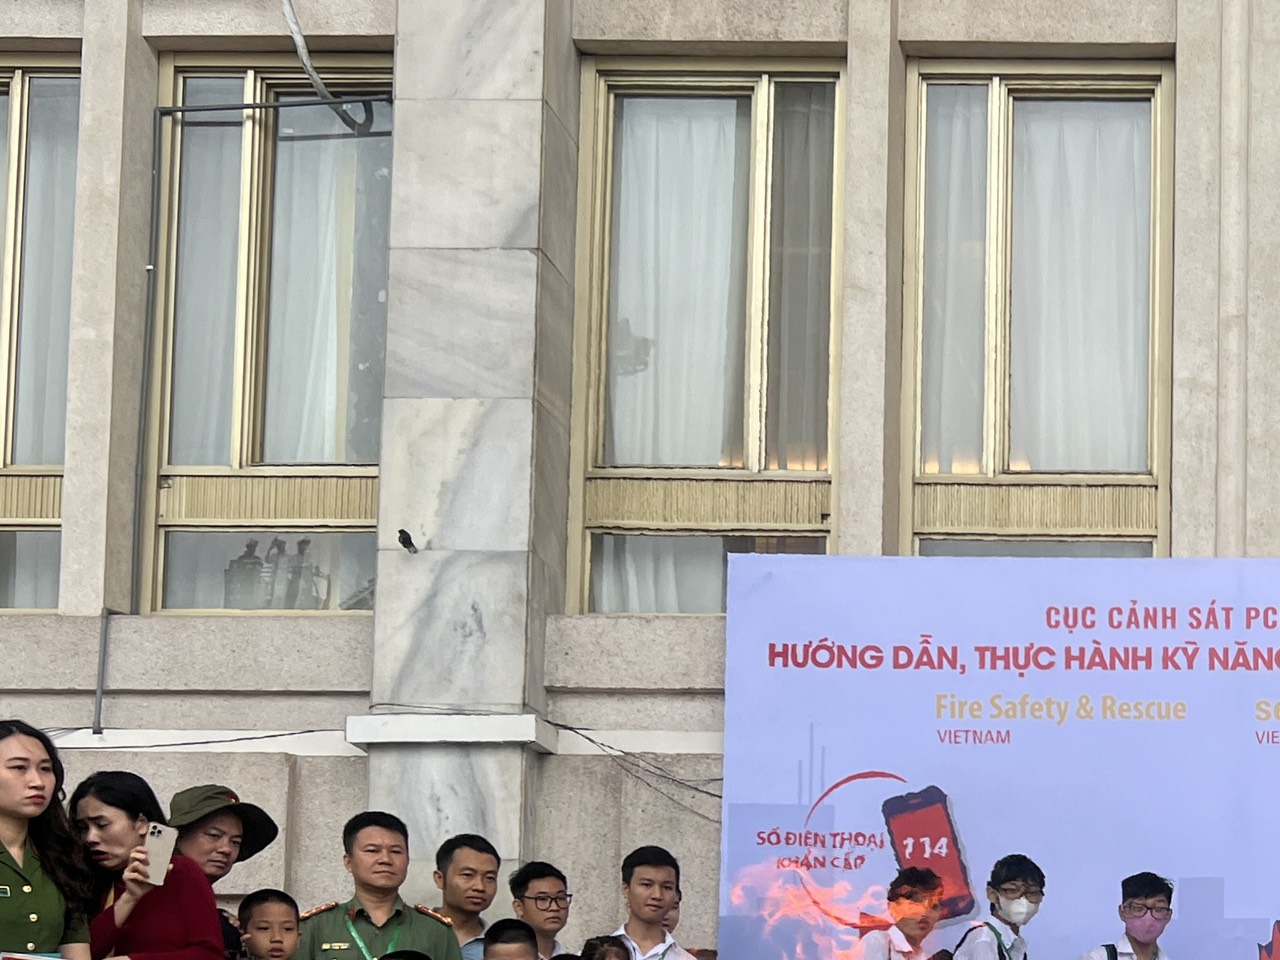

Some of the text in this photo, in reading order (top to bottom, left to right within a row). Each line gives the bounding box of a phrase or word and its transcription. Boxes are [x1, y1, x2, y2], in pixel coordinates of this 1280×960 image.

[1045, 606, 1096, 634] CỤC
[1107, 599, 1177, 630] CẢNH
[1188, 599, 1234, 630] SÁT
[768, 637, 884, 670] HƯỚNG
[973, 642, 1057, 678] THỰC
[1064, 639, 1153, 671] HÀNH
[1161, 640, 1200, 671] KỸ
[935, 692, 1187, 727] Fire Safety & Rescue
[936, 729, 1011, 745] VIETNAM
[756, 827, 781, 846] SỐ
